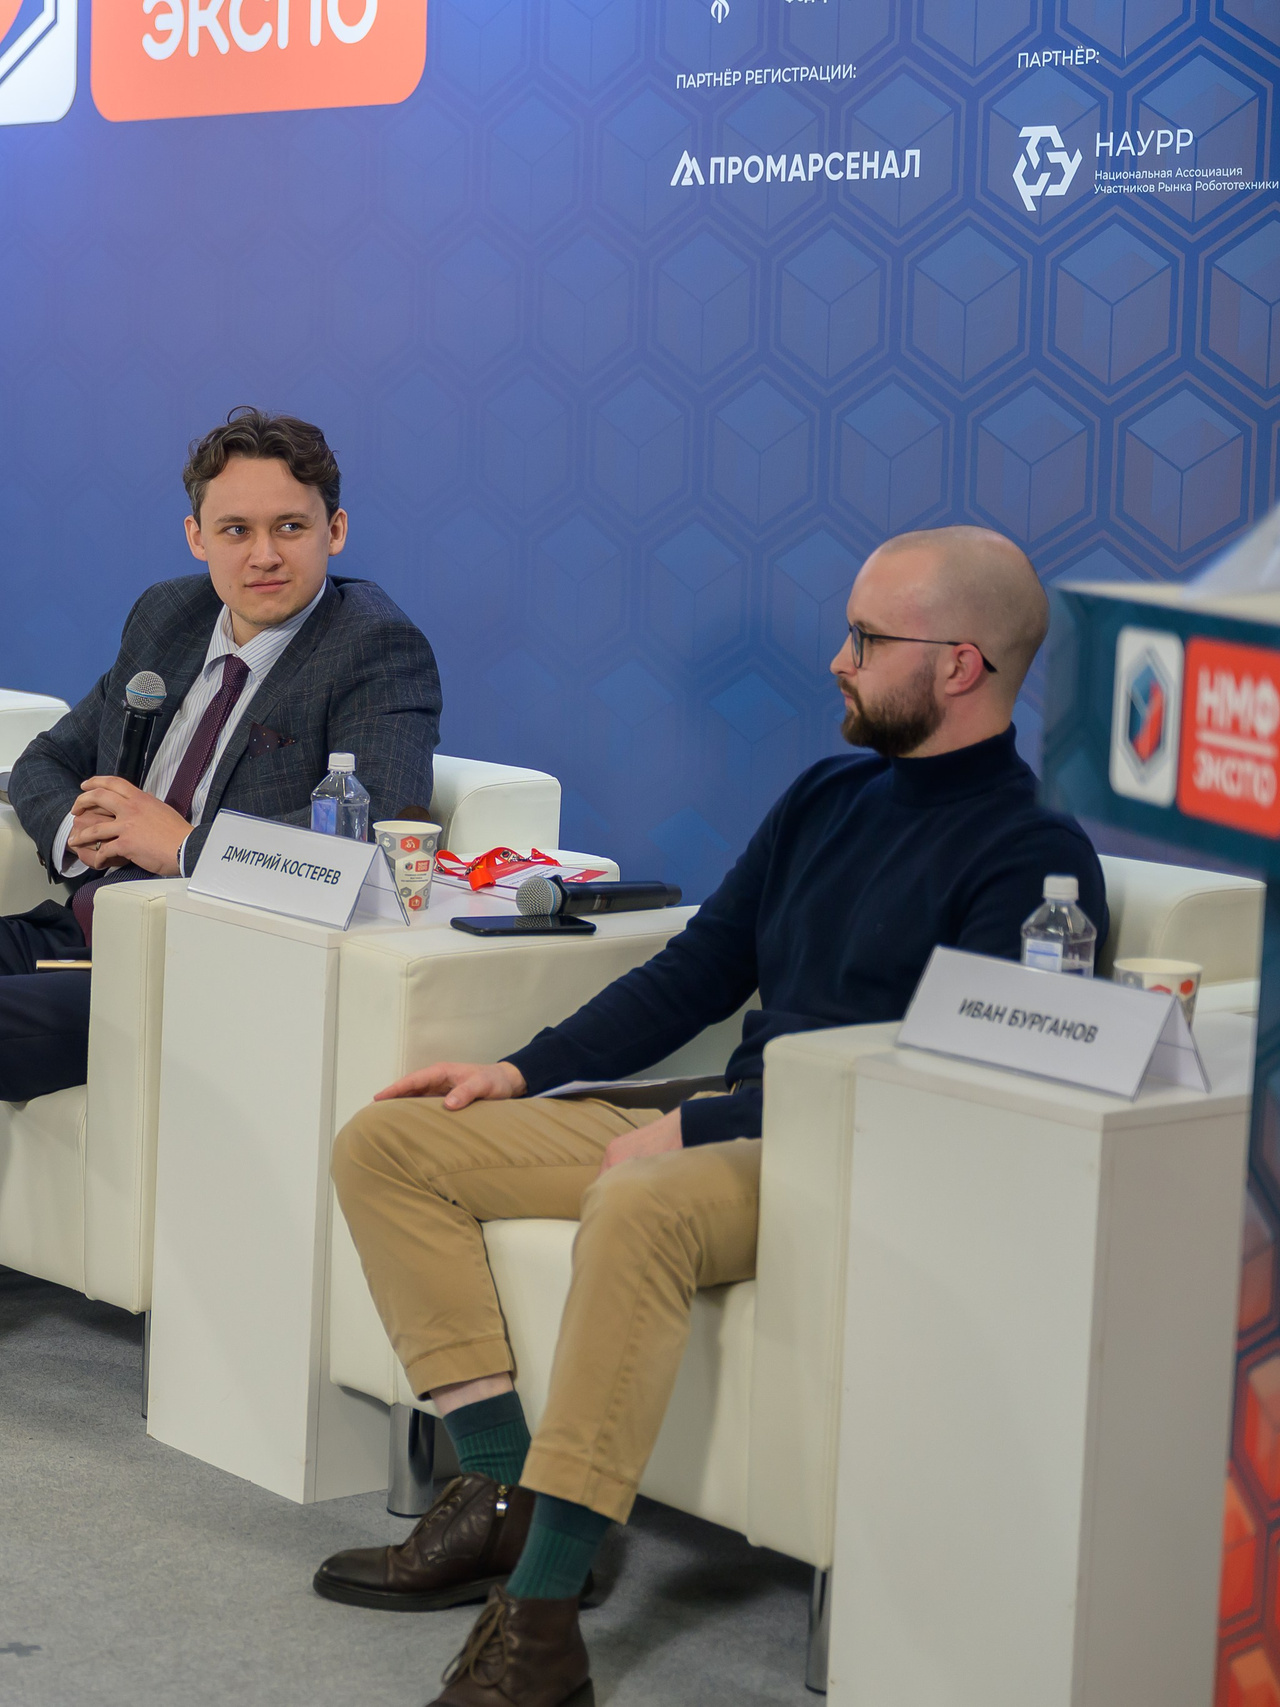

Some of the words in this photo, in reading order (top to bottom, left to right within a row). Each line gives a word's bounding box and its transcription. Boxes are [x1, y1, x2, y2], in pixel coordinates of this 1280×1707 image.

[1017, 45, 1100, 68] ПАРТНЁР:
[676, 68, 742, 89] ПАРТНЁР
[745, 64, 857, 85] РЕГИСТРАЦИИ:
[1094, 128, 1194, 157] НАУРР
[709, 149, 921, 185] ПРОМАРСЕНАЛ
[1094, 168, 1173, 182] Национальная
[1175, 166, 1243, 180] Ассоциация
[1093, 182, 1155, 195] Участников
[1158, 181, 1192, 193] Рынка
[1195, 179, 1280, 192] Робототехники
[221, 844, 282, 872] ДМИТРИЙ
[279, 856, 342, 886] КОСТЕРЕВ
[958, 998, 1007, 1024] ИВАН
[1007, 1008, 1099, 1044] БУРГАНОВ
